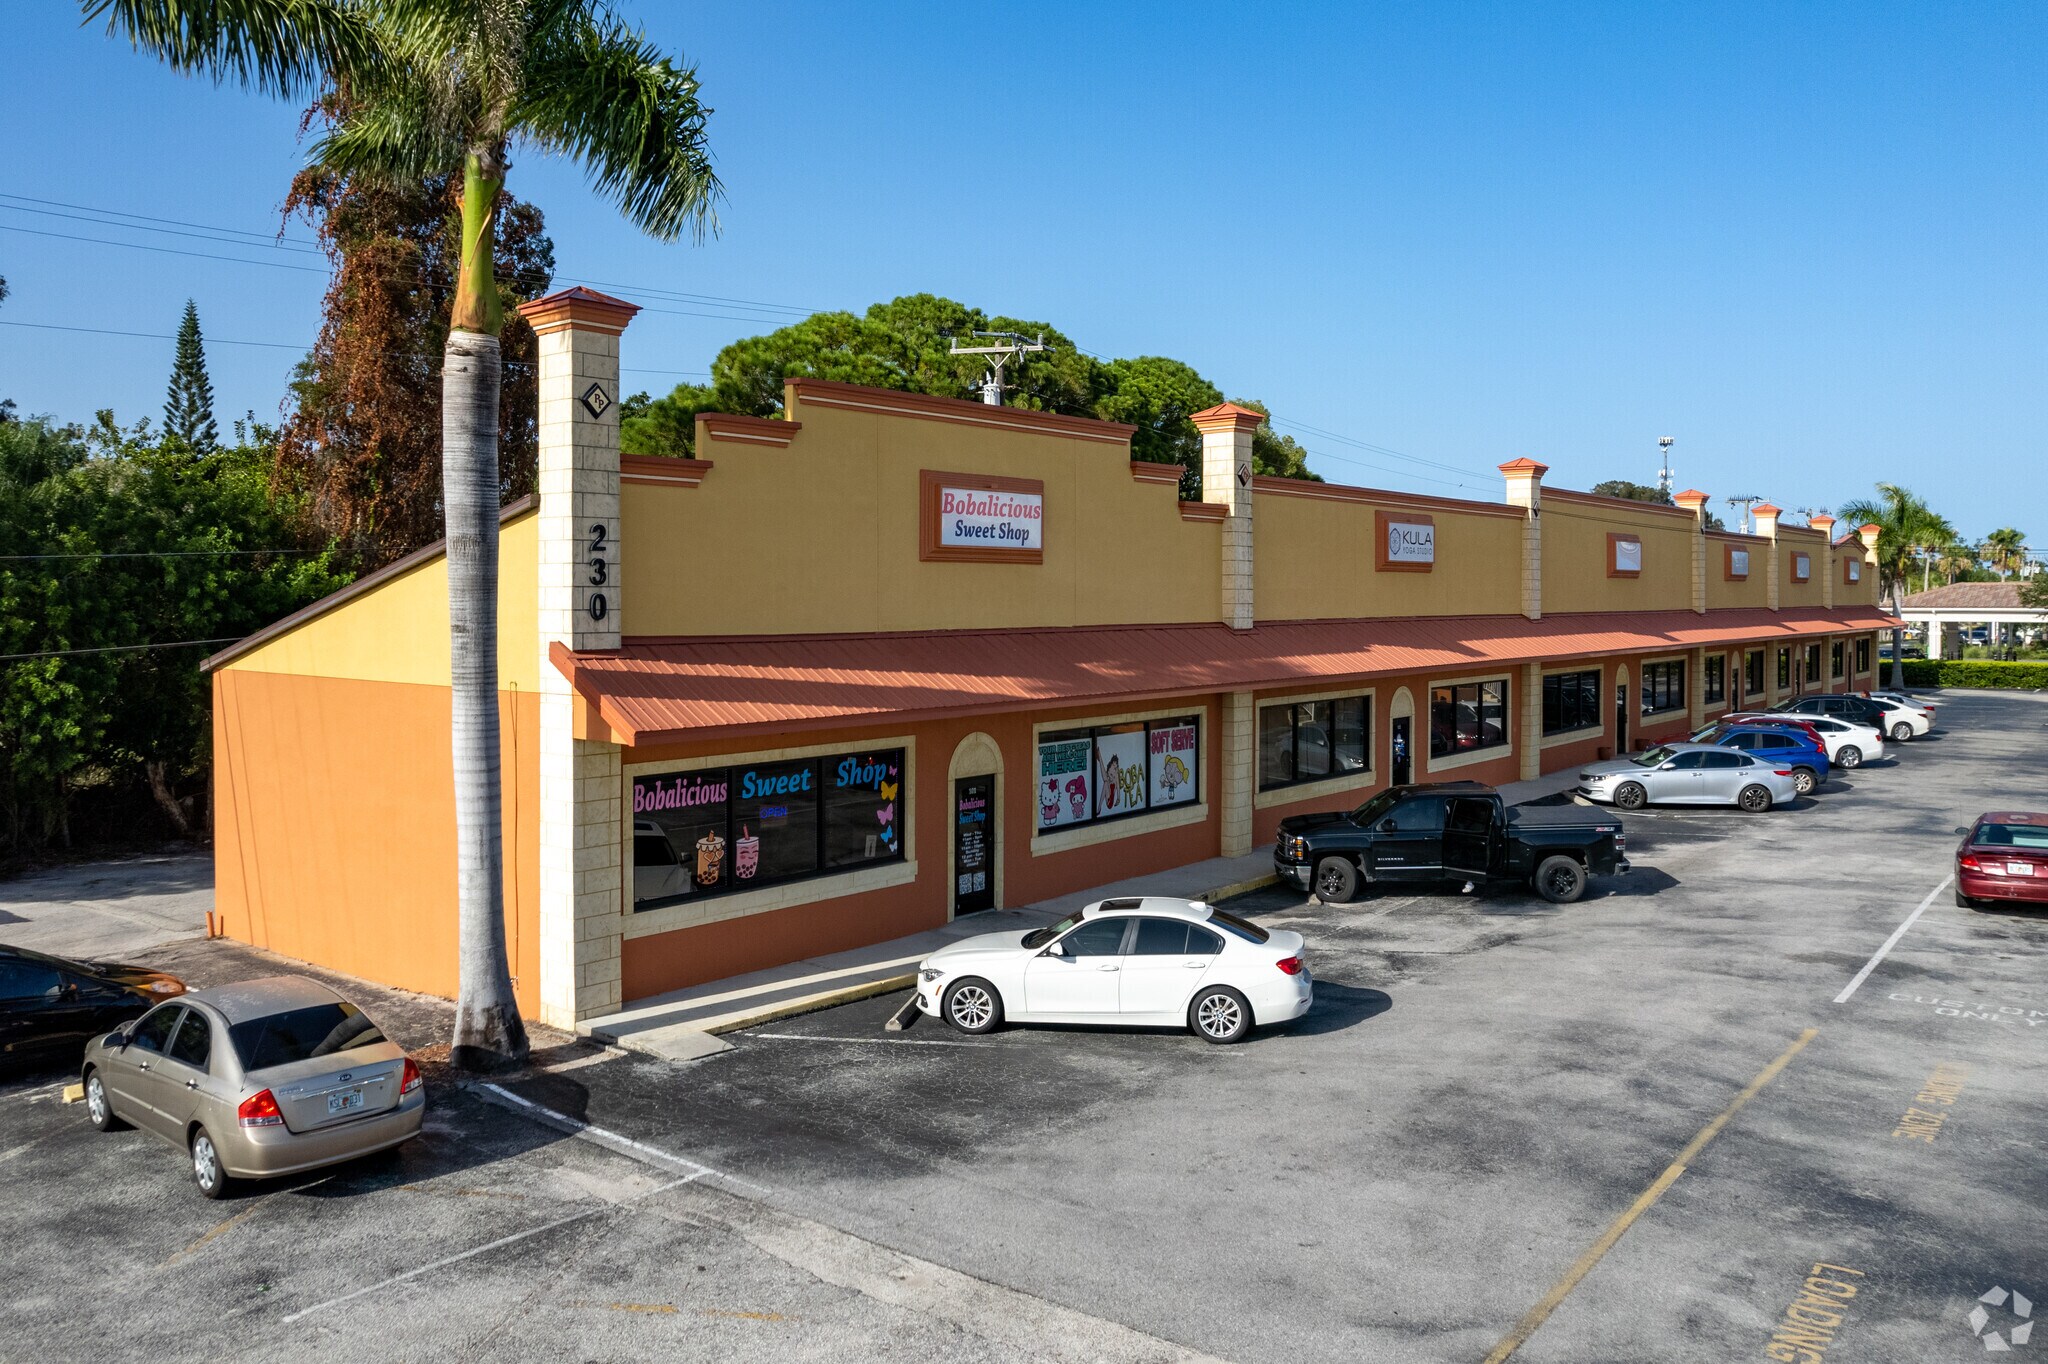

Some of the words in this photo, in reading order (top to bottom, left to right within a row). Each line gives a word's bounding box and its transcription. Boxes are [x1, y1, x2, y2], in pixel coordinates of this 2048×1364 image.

[942, 493, 1041, 520] Bobalicious
[955, 519, 996, 539] Sweet
[998, 522, 1030, 546] Shop
[1402, 530, 1433, 546] KULA
[589, 523, 607, 621] 230
[1038, 744, 1056, 756] YOUR
[1151, 731, 1171, 755] SOFT
[1171, 727, 1194, 752] SERVE
[1042, 753, 1057, 763] ARE
[1057, 749, 1087, 762] WELCOME
[1042, 758, 1087, 776] HERE!
[634, 777, 728, 813] Bobalicious
[742, 768, 812, 799] Sweet
[836, 757, 887, 790] Shop
[1118, 763, 1145, 789] BOBA
[959, 797, 985, 811] Bobalicious
[1123, 783, 1143, 809] TEA
[759, 806, 788, 819] OPEN
[1934, 1007, 2046, 1026] ONLY
[1891, 1107, 1949, 1144] ZONE
[1765, 1262, 1865, 1364] LOADING
